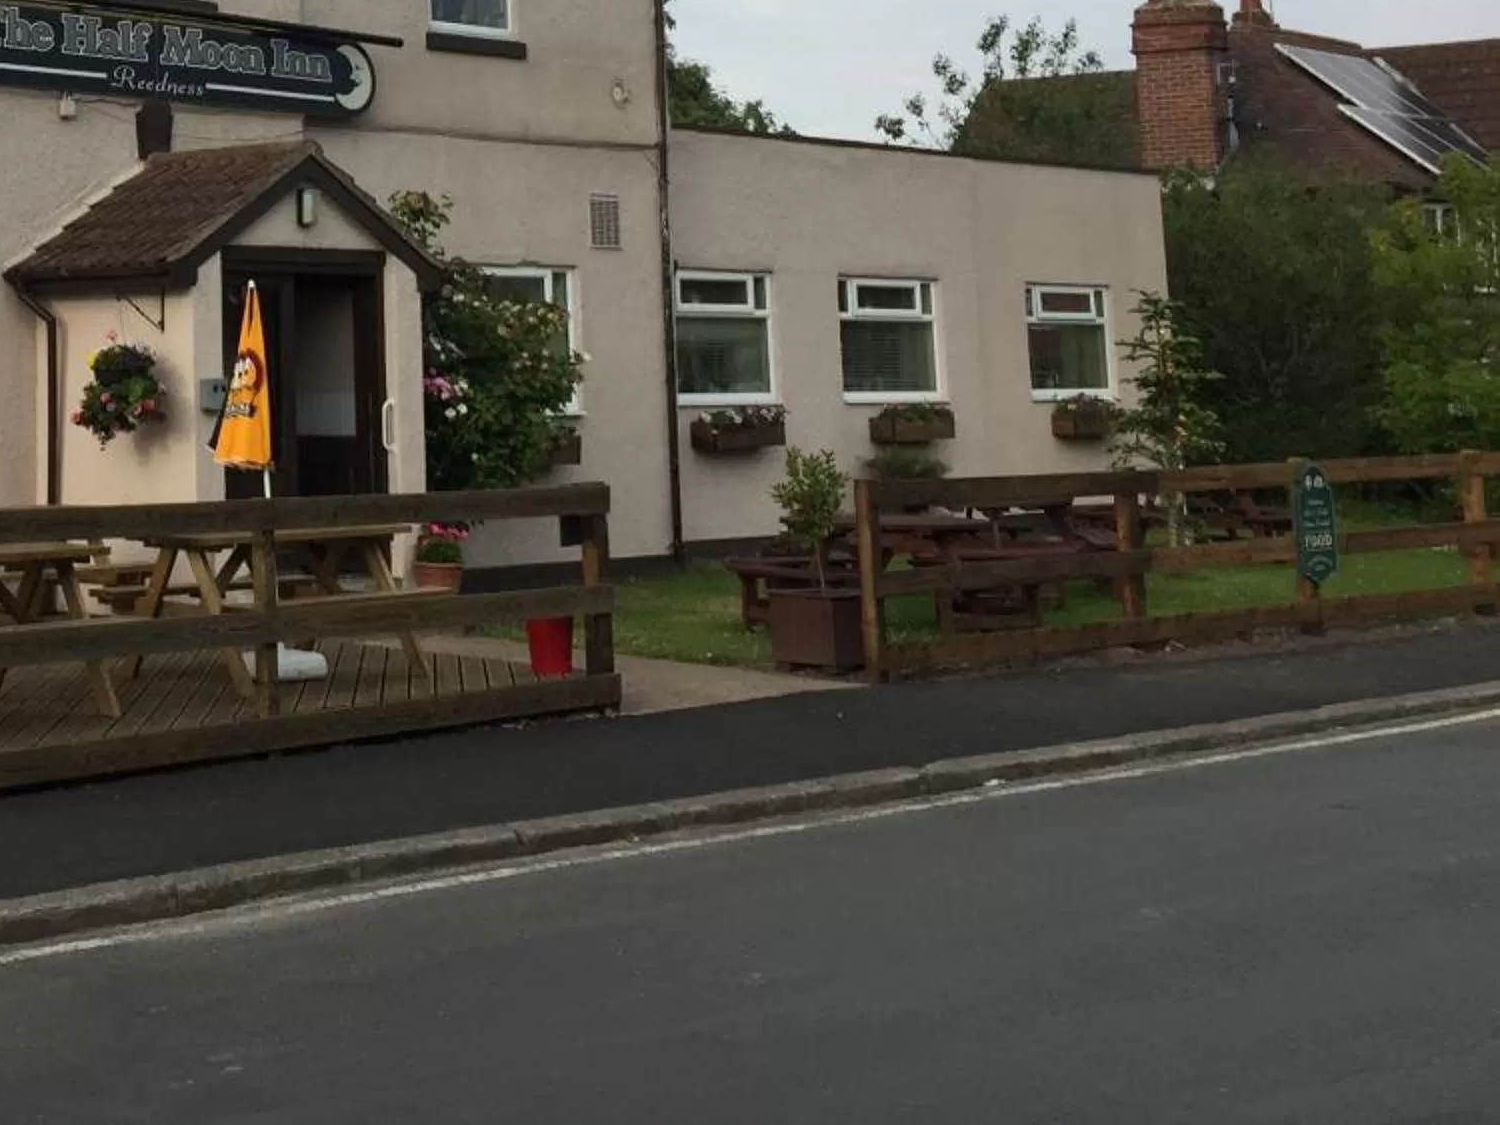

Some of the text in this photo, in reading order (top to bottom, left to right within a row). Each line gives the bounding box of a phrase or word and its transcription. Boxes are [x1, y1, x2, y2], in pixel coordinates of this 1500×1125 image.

[61, 12, 153, 62] Half
[160, 25, 267, 75] Moon
[270, 38, 333, 83] Inn
[110, 65, 204, 96] Reedness
